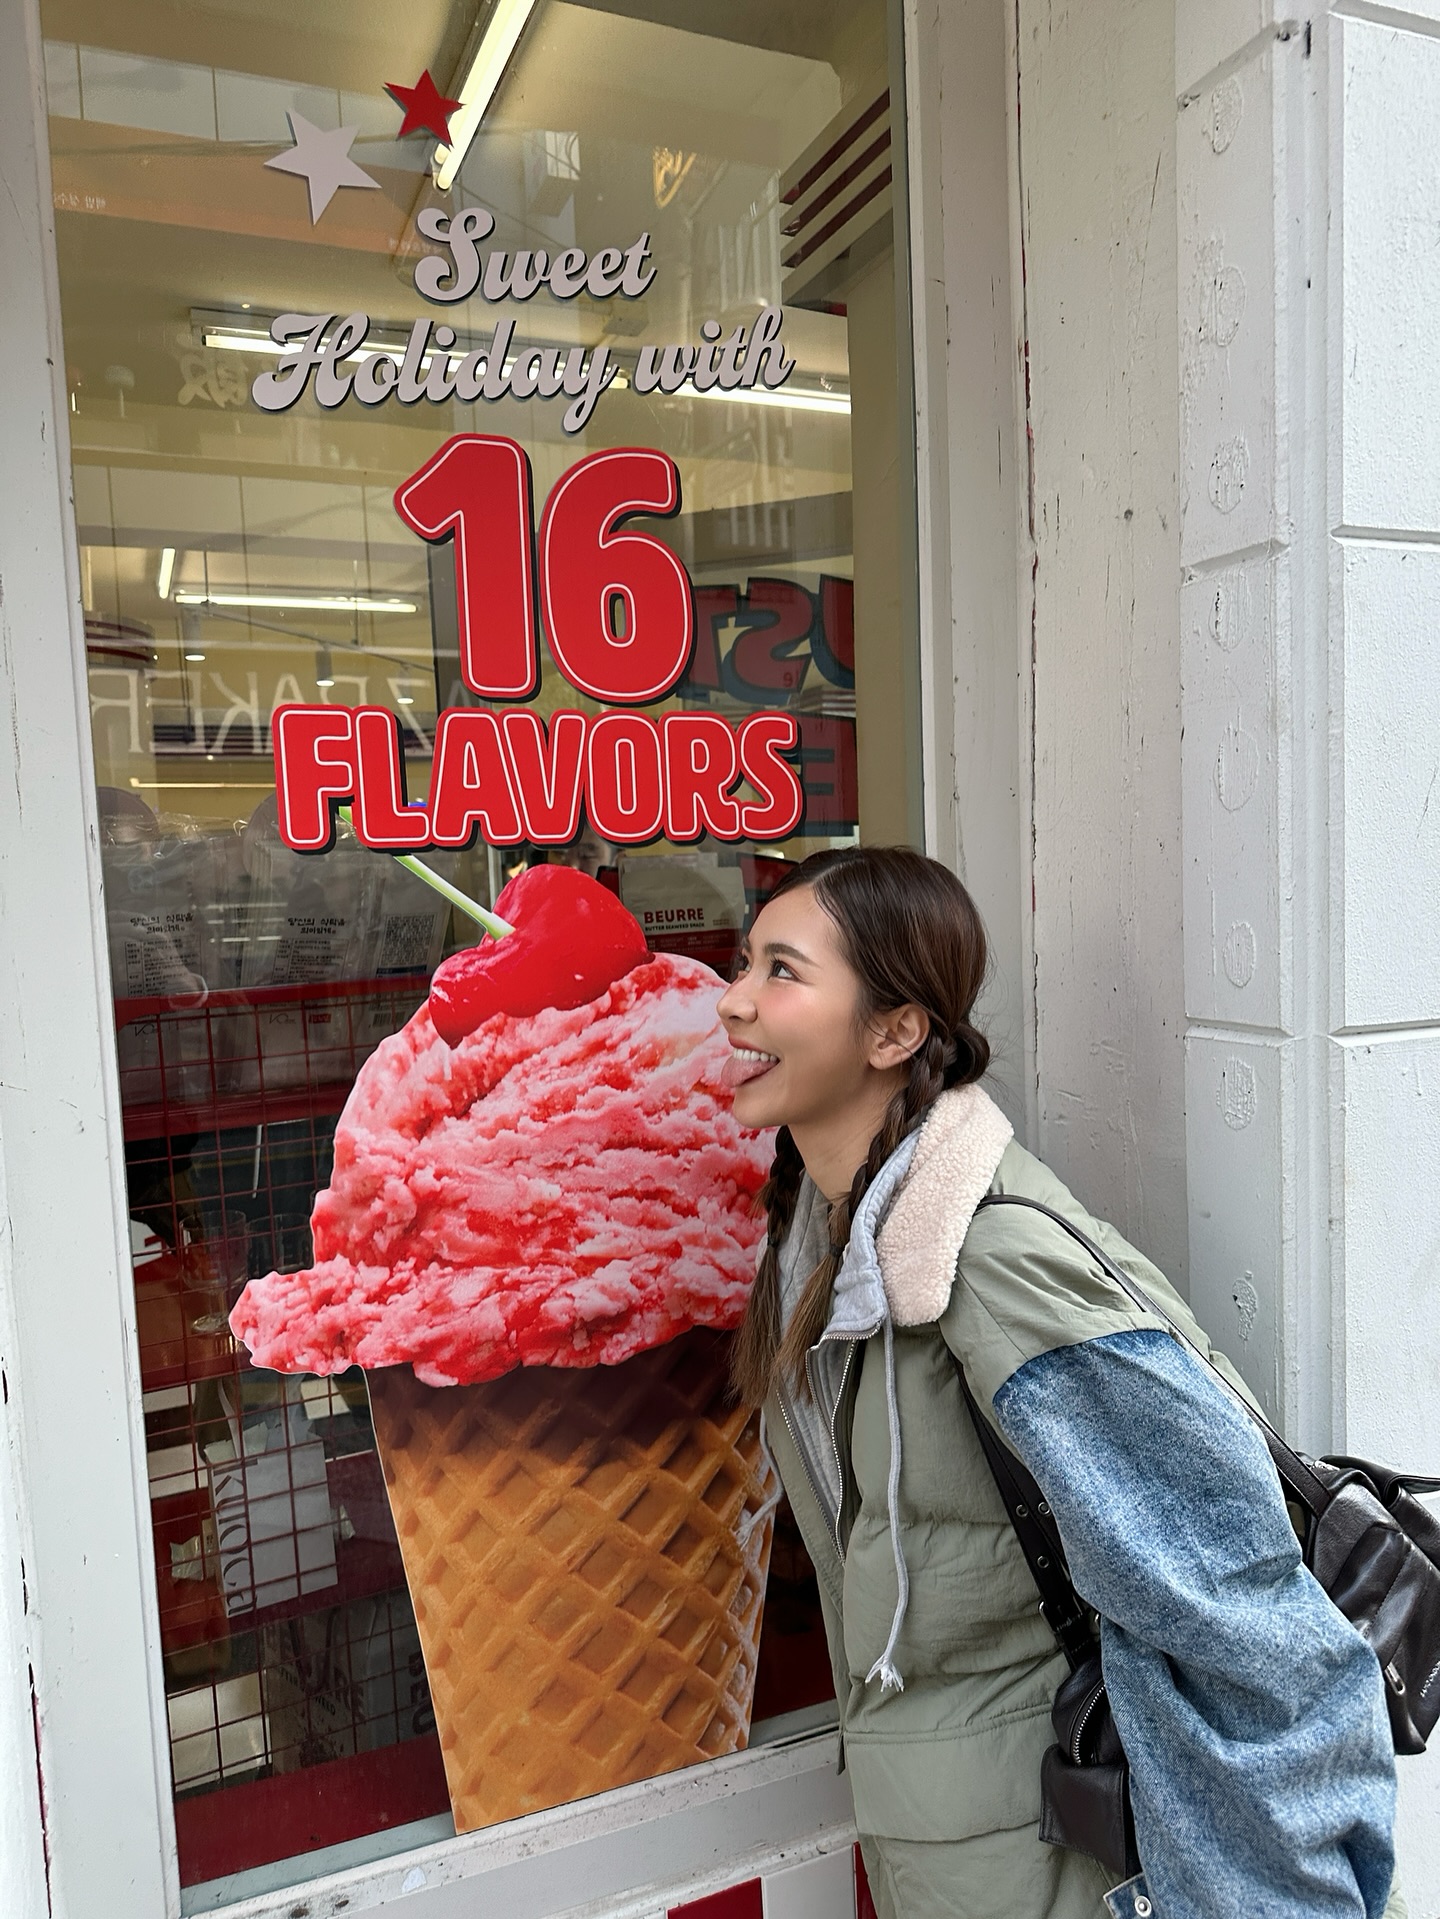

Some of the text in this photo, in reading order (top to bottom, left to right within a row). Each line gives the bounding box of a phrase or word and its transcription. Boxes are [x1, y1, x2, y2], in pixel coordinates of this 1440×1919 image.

[414, 206, 657, 305] Sweet
[251, 306, 797, 434] Holiday with
[394, 433, 696, 706] 16
[274, 704, 805, 854] FLAVORS
[643, 908, 704, 923] BEURRE
